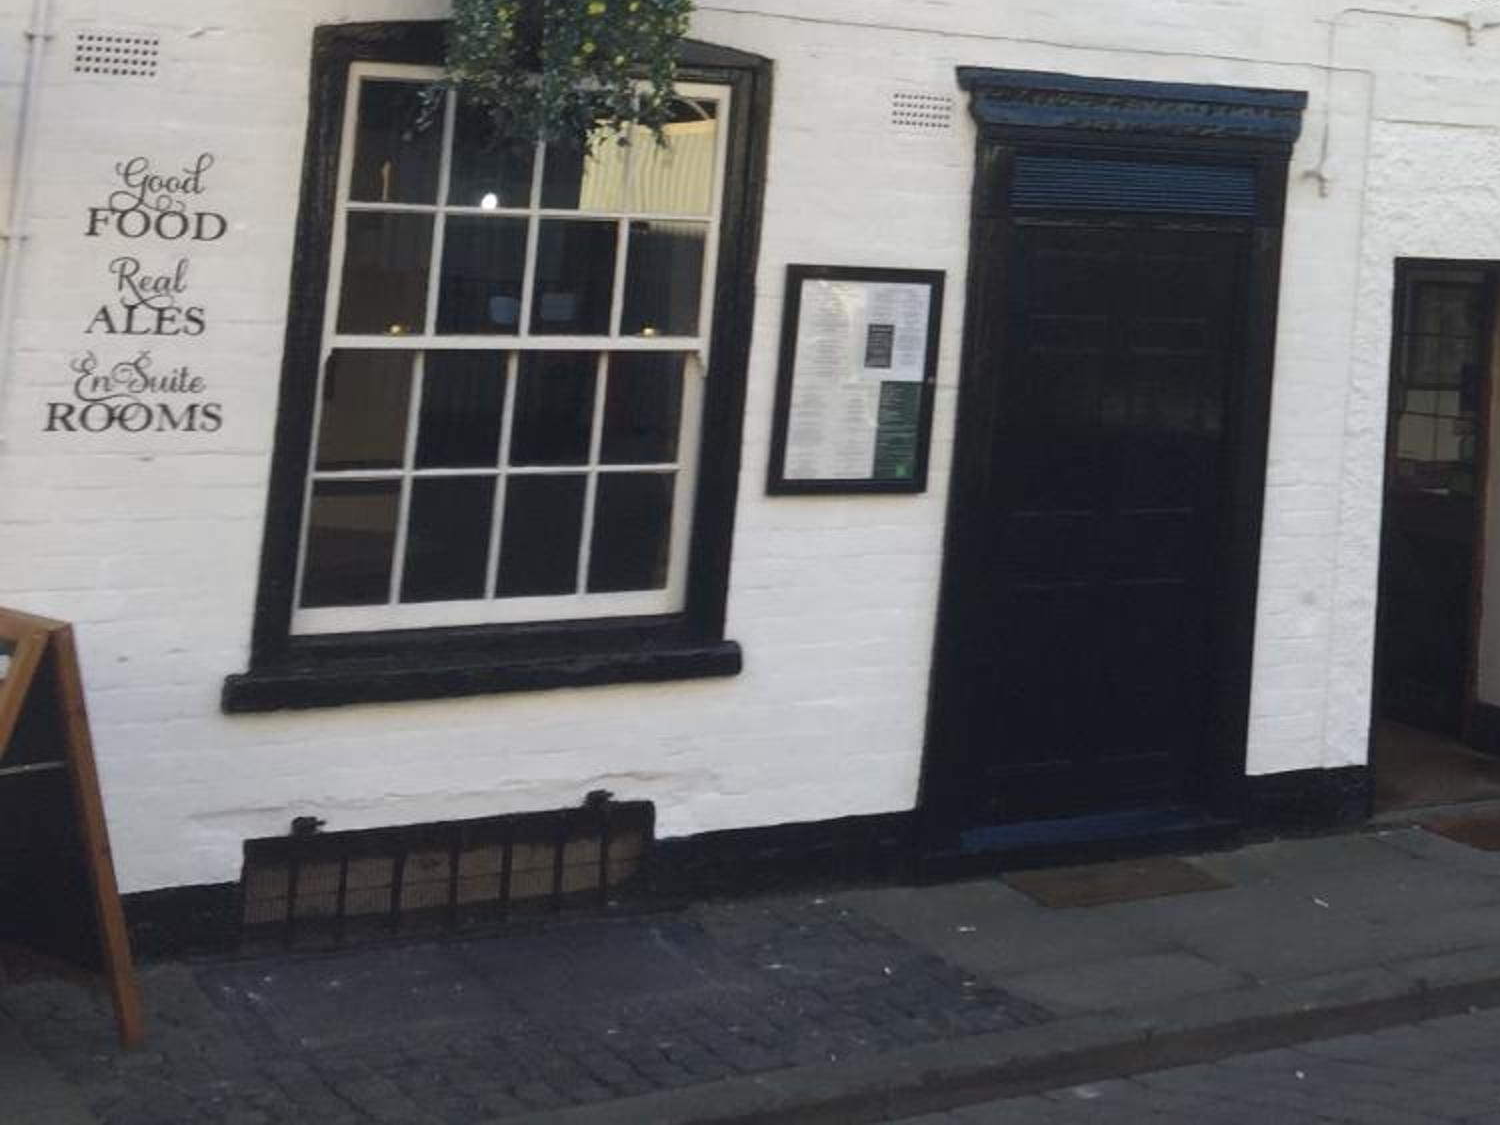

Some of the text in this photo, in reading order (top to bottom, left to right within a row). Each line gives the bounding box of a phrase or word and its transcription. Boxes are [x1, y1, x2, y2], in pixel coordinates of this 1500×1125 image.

[109, 152, 215, 214] Good
[84, 207, 228, 242] FOOD
[108, 256, 190, 311] Real
[84, 305, 206, 336] ALES
[112, 350, 206, 394] Suite
[42, 401, 224, 433] ROOMS
